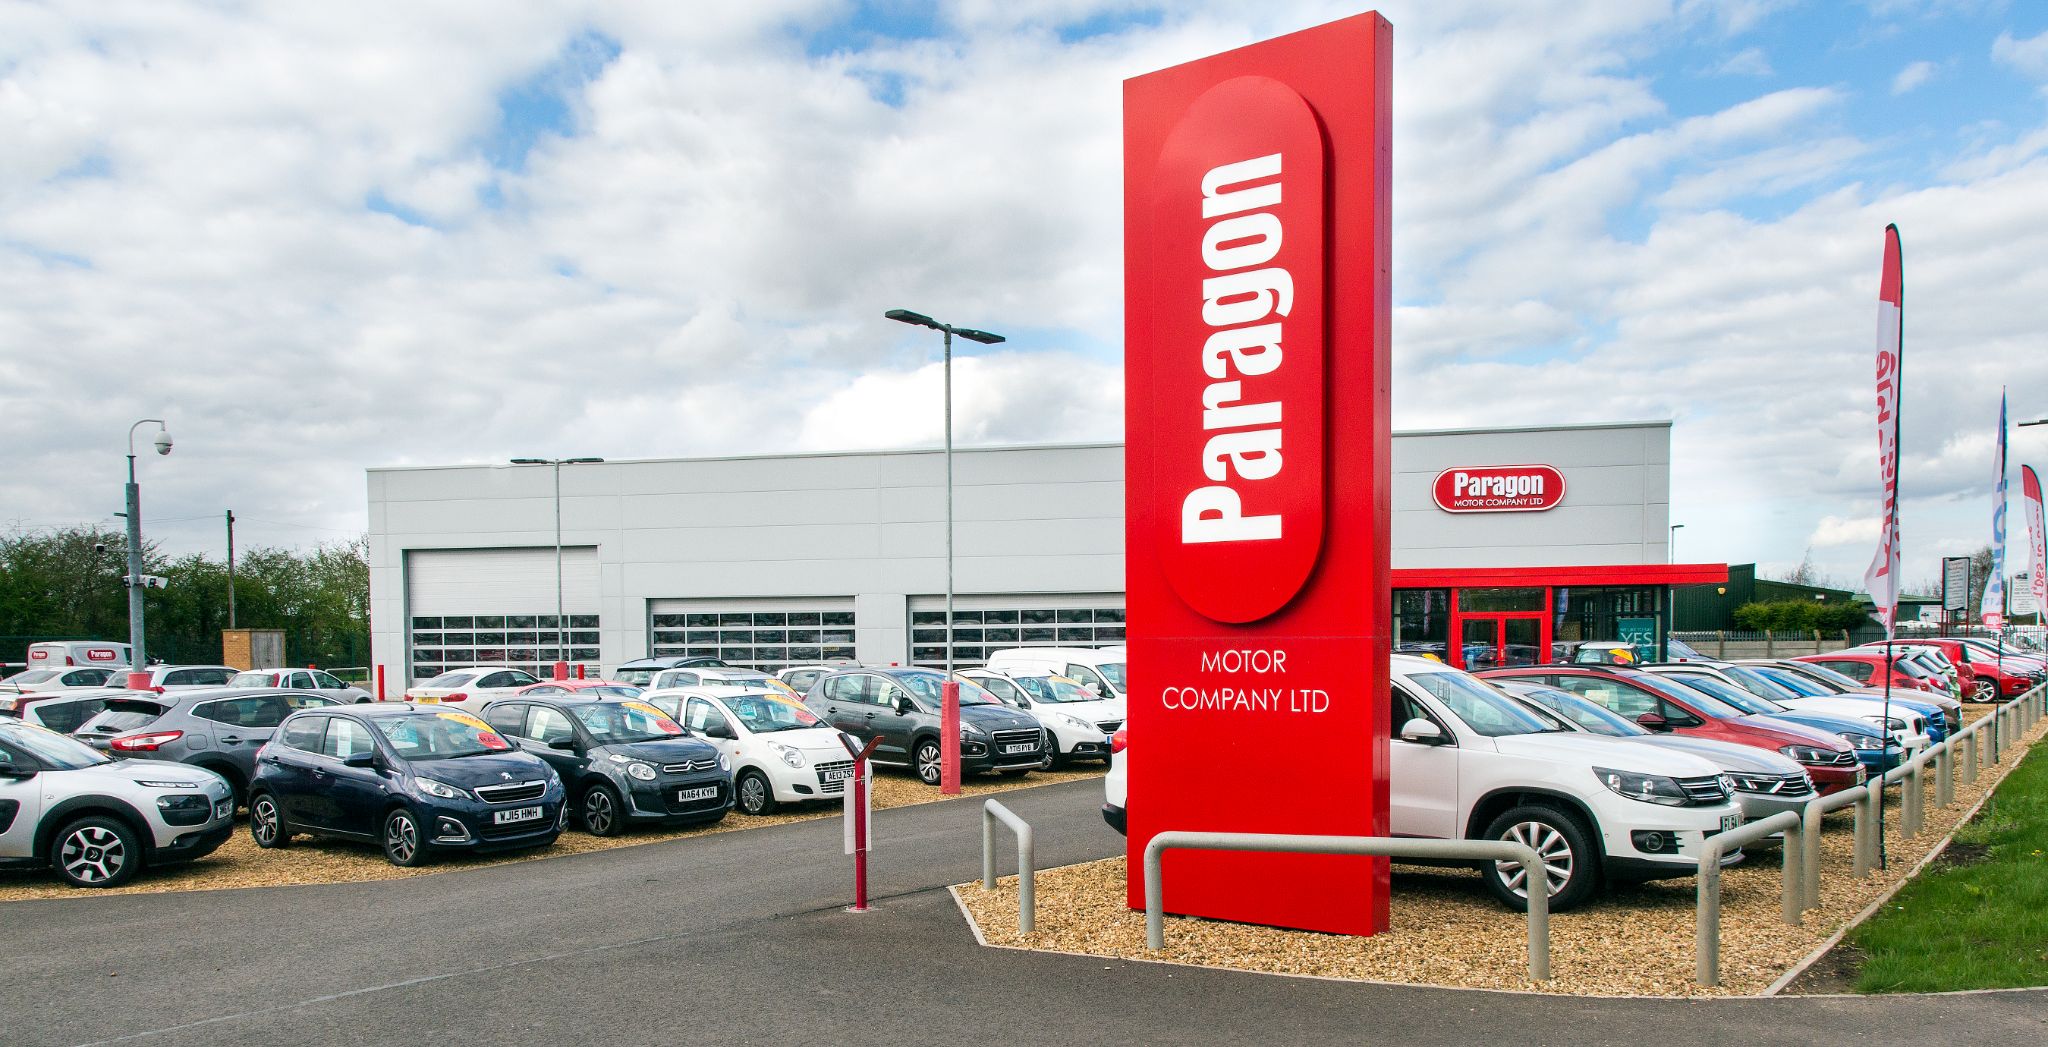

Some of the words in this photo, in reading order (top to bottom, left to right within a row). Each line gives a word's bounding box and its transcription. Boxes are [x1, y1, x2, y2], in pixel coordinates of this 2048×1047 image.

[1182, 152, 1295, 545] Paragon
[1454, 472, 1544, 498] Paragon
[1454, 499, 1484, 507] MOTOR
[1486, 498, 1528, 506] COMPANY
[1530, 497, 1544, 505] LTD
[1620, 631, 1653, 646] YES
[90, 650, 112, 658] Paragon
[1201, 649, 1287, 673] MOTOR
[1162, 686, 1283, 711] COMPANY
[1290, 689, 1330, 713] LTD
[828, 772, 842, 780] AE13
[843, 770, 855, 779] ZSZ
[681, 789, 700, 800] NA64
[701, 787, 715, 798] KYH
[500, 810, 519, 822] WJ15
[522, 808, 538, 819] HMH
